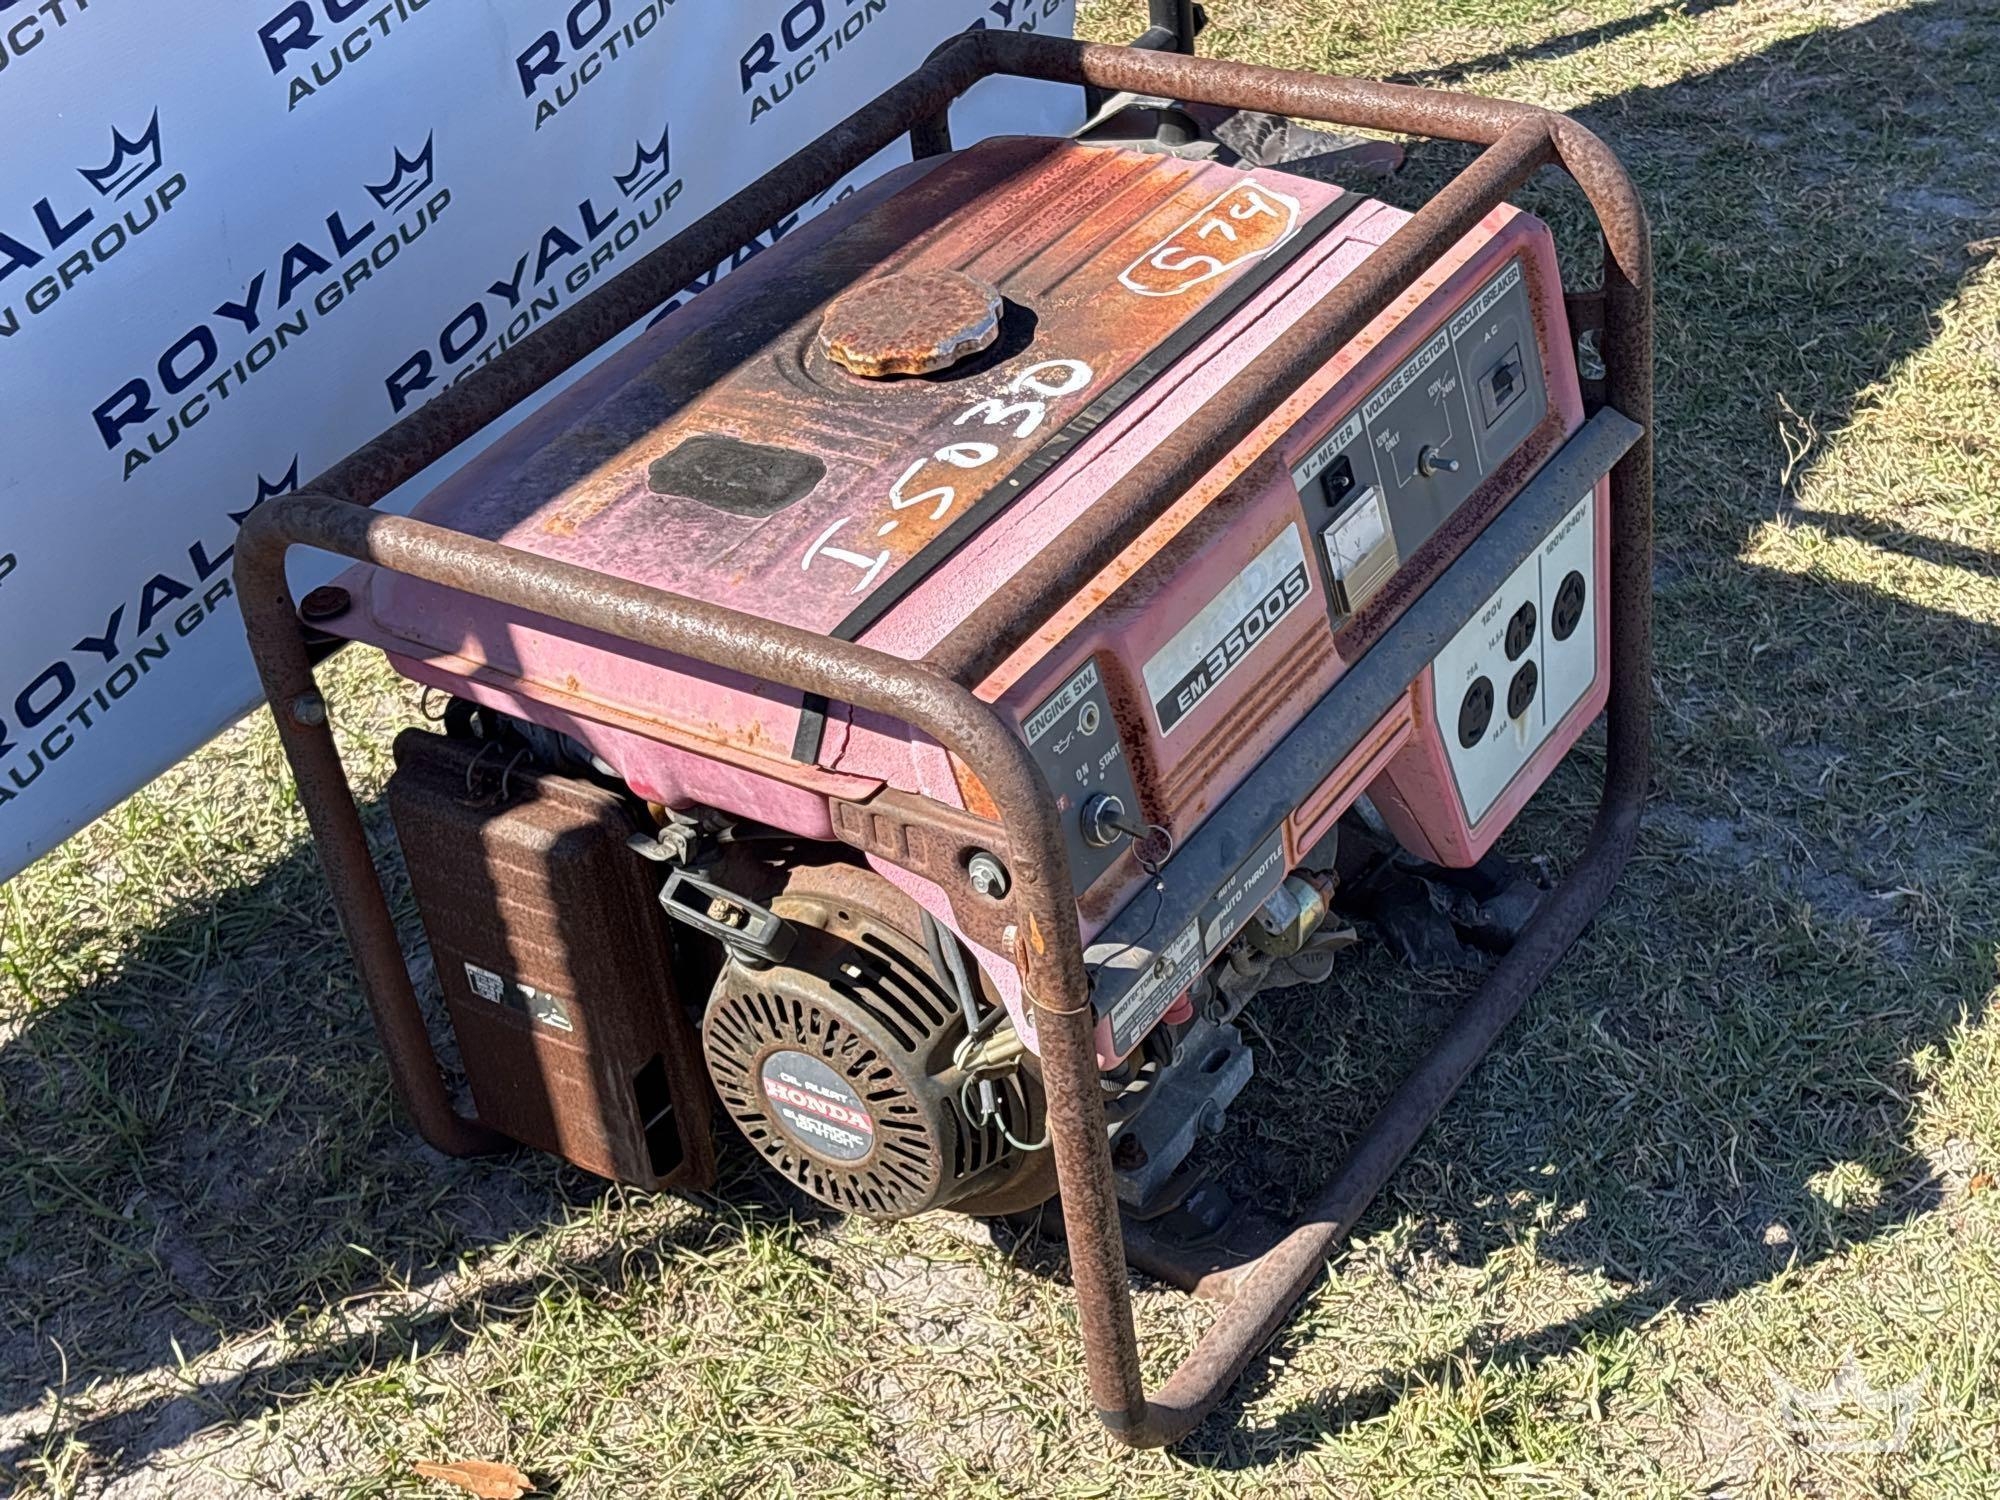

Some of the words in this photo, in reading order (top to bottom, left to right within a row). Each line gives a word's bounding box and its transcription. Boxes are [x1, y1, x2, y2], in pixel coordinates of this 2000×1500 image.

[289, 0, 430, 112] AUCTI
[25, 173, 187, 314] GROUP
[566, 179, 684, 293] GROUP
[92, 210, 376, 450] ROYAL
[123, 308, 310, 482] AUCTION
[314, 188, 451, 316] GROUP
[385, 199, 619, 414] ROYAL
[1451, 300, 1483, 336] CIRCUIT
[1481, 267, 1519, 309] BREAKER
[1365, 375, 1404, 419] VOLTAGE
[1403, 335, 1447, 384] SELECTOR
[1302, 425, 1355, 480] V-METER
[0, 540, 234, 759] OYAL
[1481, 597, 1503, 627] 120V
[1028, 690, 1072, 739] ENGINE
[1073, 670, 1095, 697] SW.
[1076, 763, 1089, 781] ON
[1099, 742, 1121, 770] START
[1220, 890, 1242, 919] AUTO
[1244, 845, 1283, 892] THROTTLE
[766, 1080, 872, 1130] HONDA
